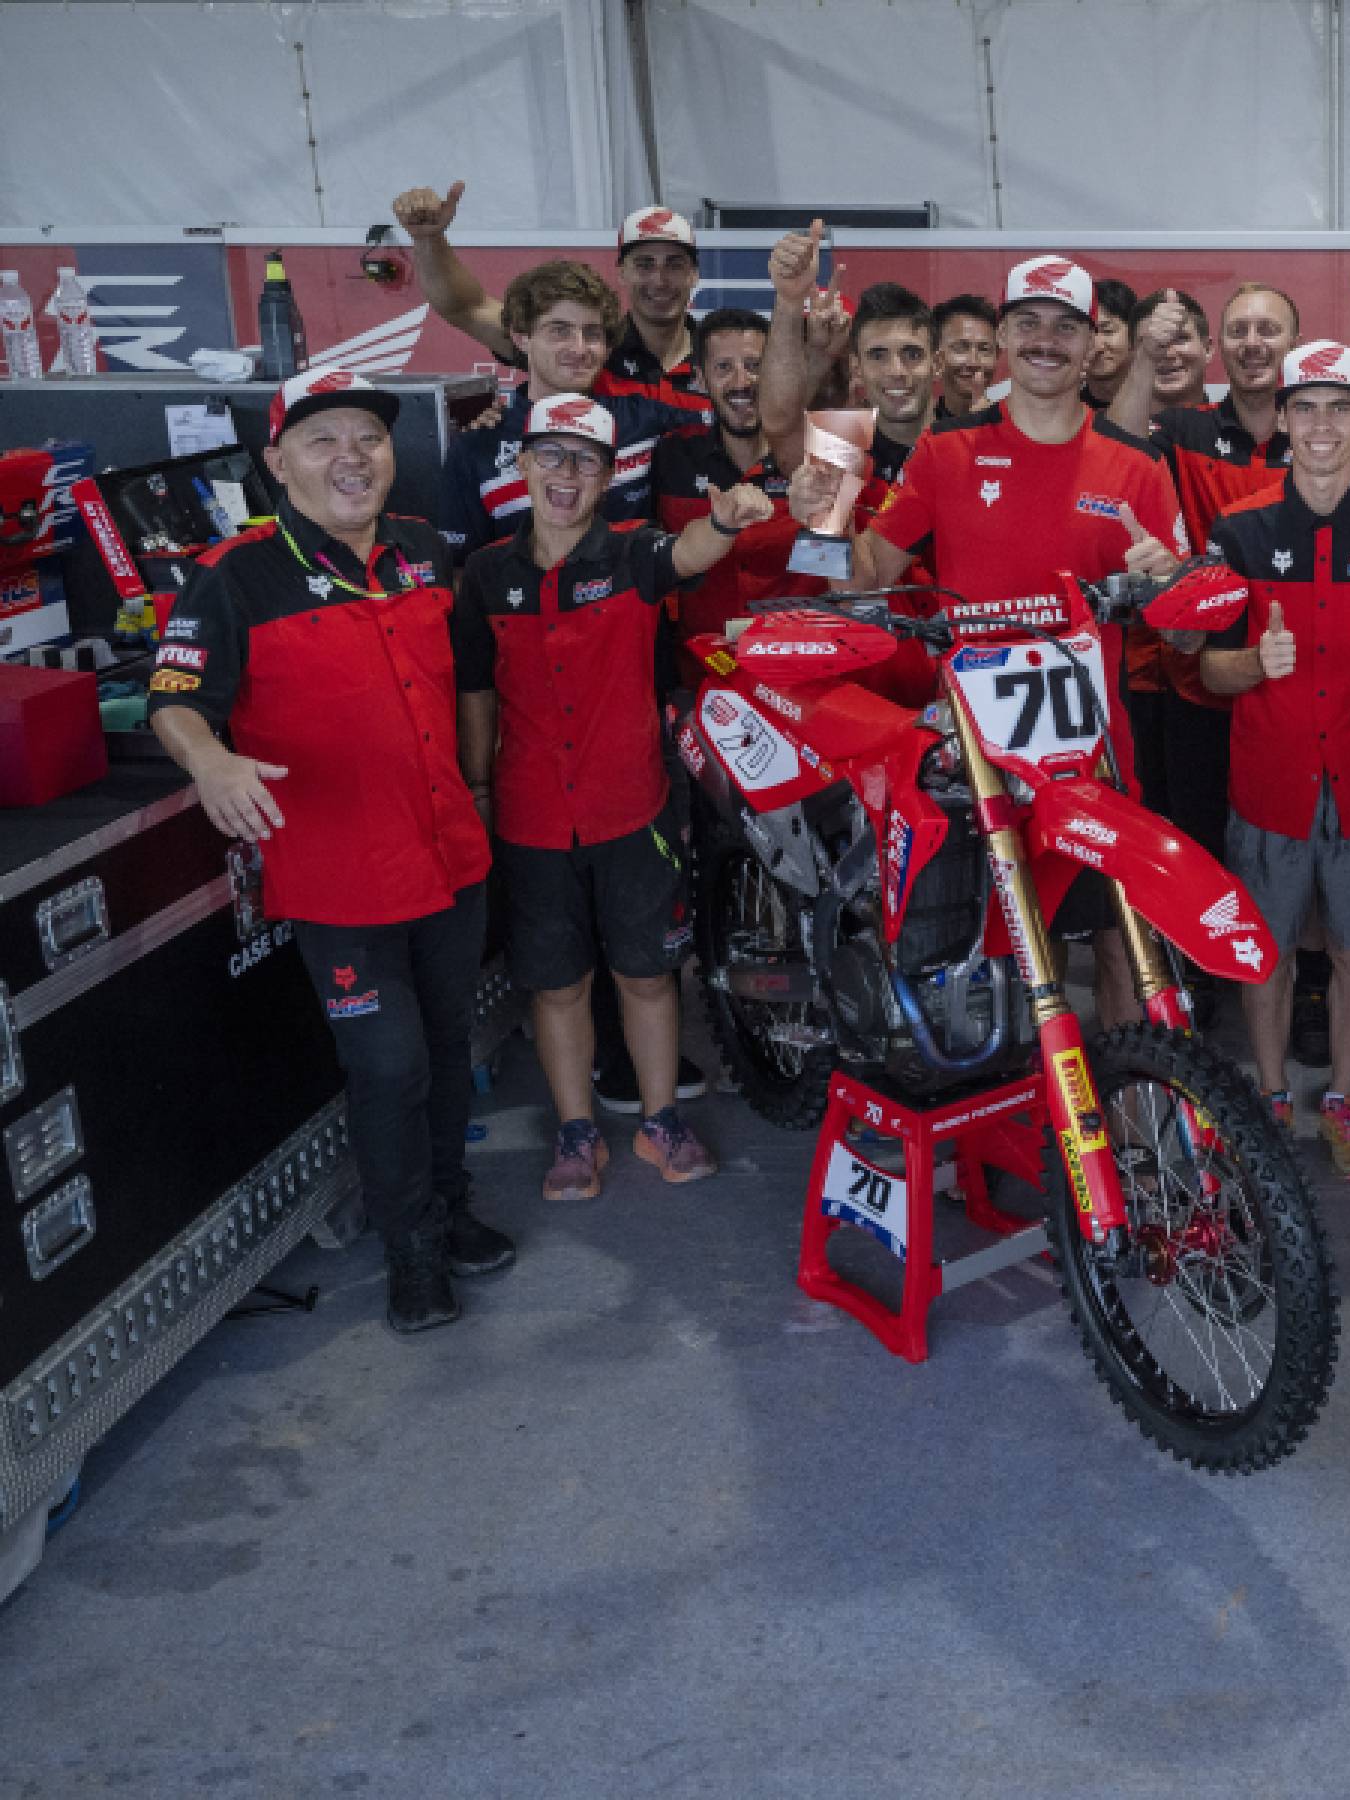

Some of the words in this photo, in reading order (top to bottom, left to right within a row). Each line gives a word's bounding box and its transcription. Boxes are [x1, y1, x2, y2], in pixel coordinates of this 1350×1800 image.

[953, 594, 1063, 617] RENTHAL
[745, 641, 838, 655] ACERBIS
[994, 668, 1099, 750] 70
[229, 932, 271, 978] CASE
[849, 1162, 890, 1213] 70
